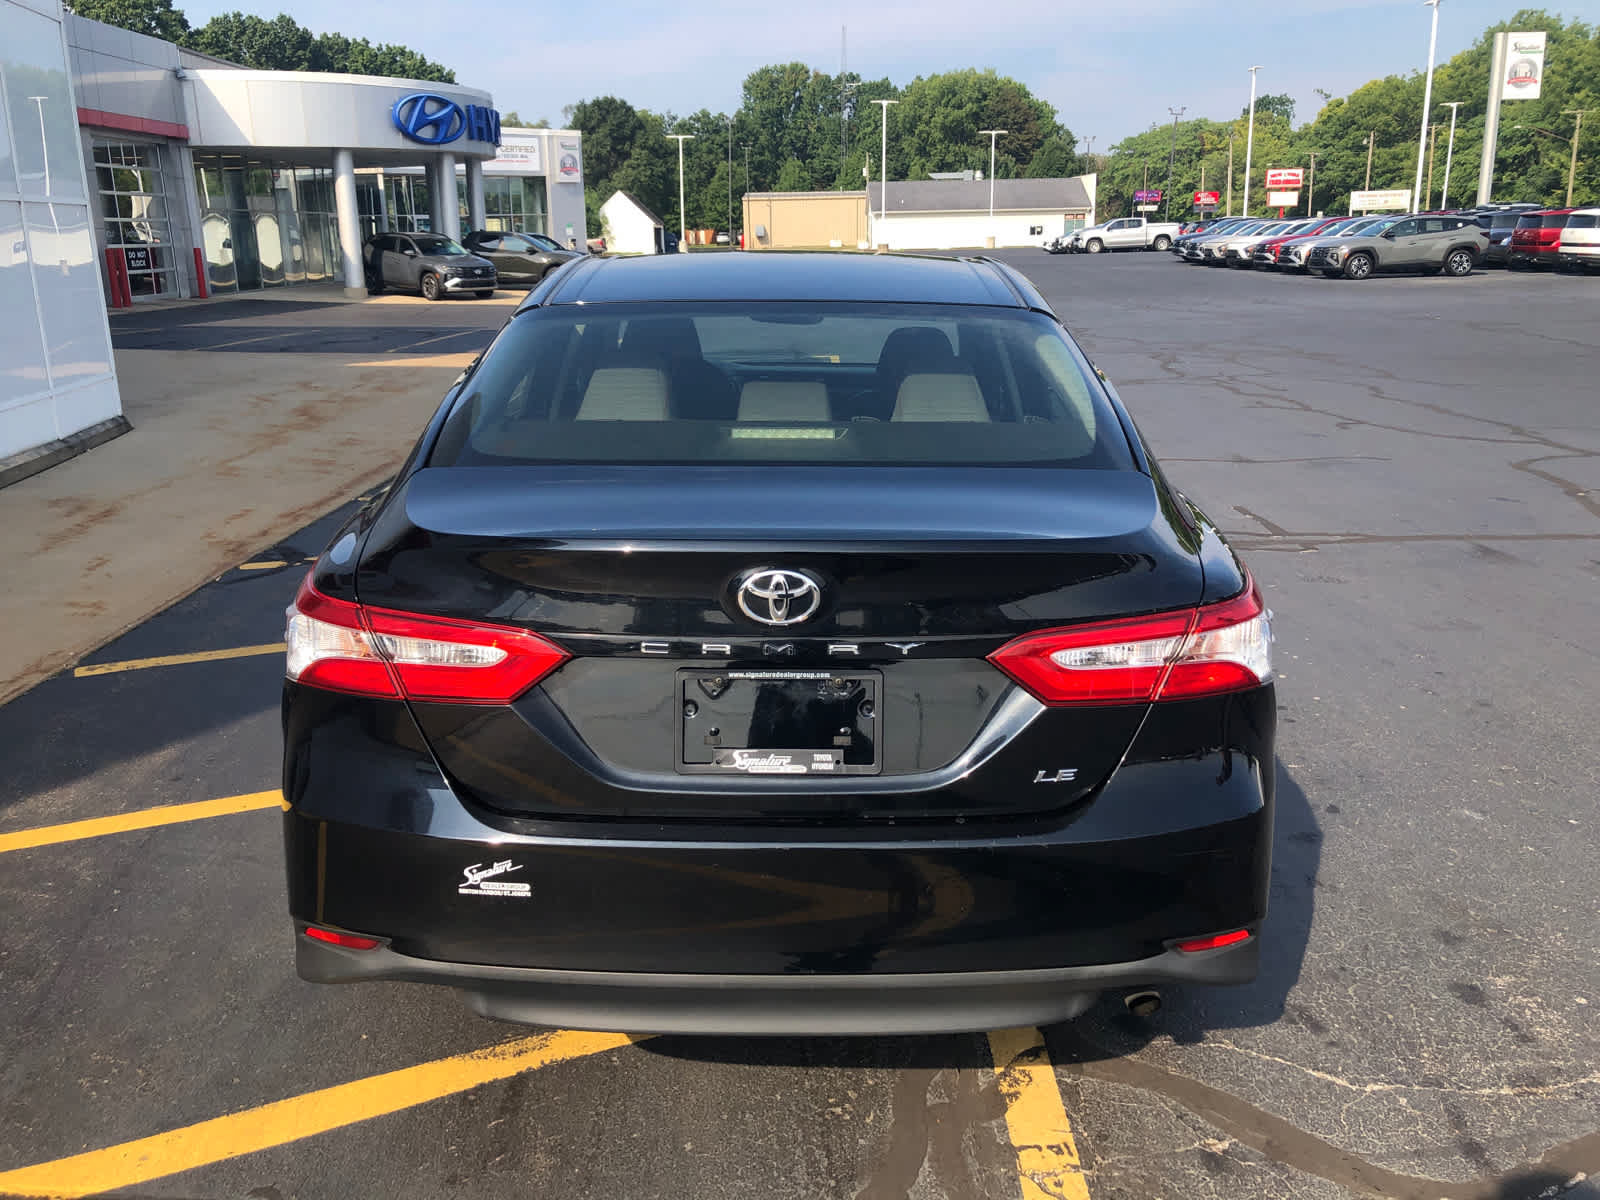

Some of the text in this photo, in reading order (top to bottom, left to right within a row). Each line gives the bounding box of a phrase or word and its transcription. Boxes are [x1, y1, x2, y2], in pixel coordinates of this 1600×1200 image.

[128, 250, 146, 259] DO NOT
[641, 641, 926, 655] CAMRY
[728, 671, 831, 680] www.signaturedealergroup.com
[720, 750, 792, 770] Signature
[1033, 769, 1078, 783] LE
